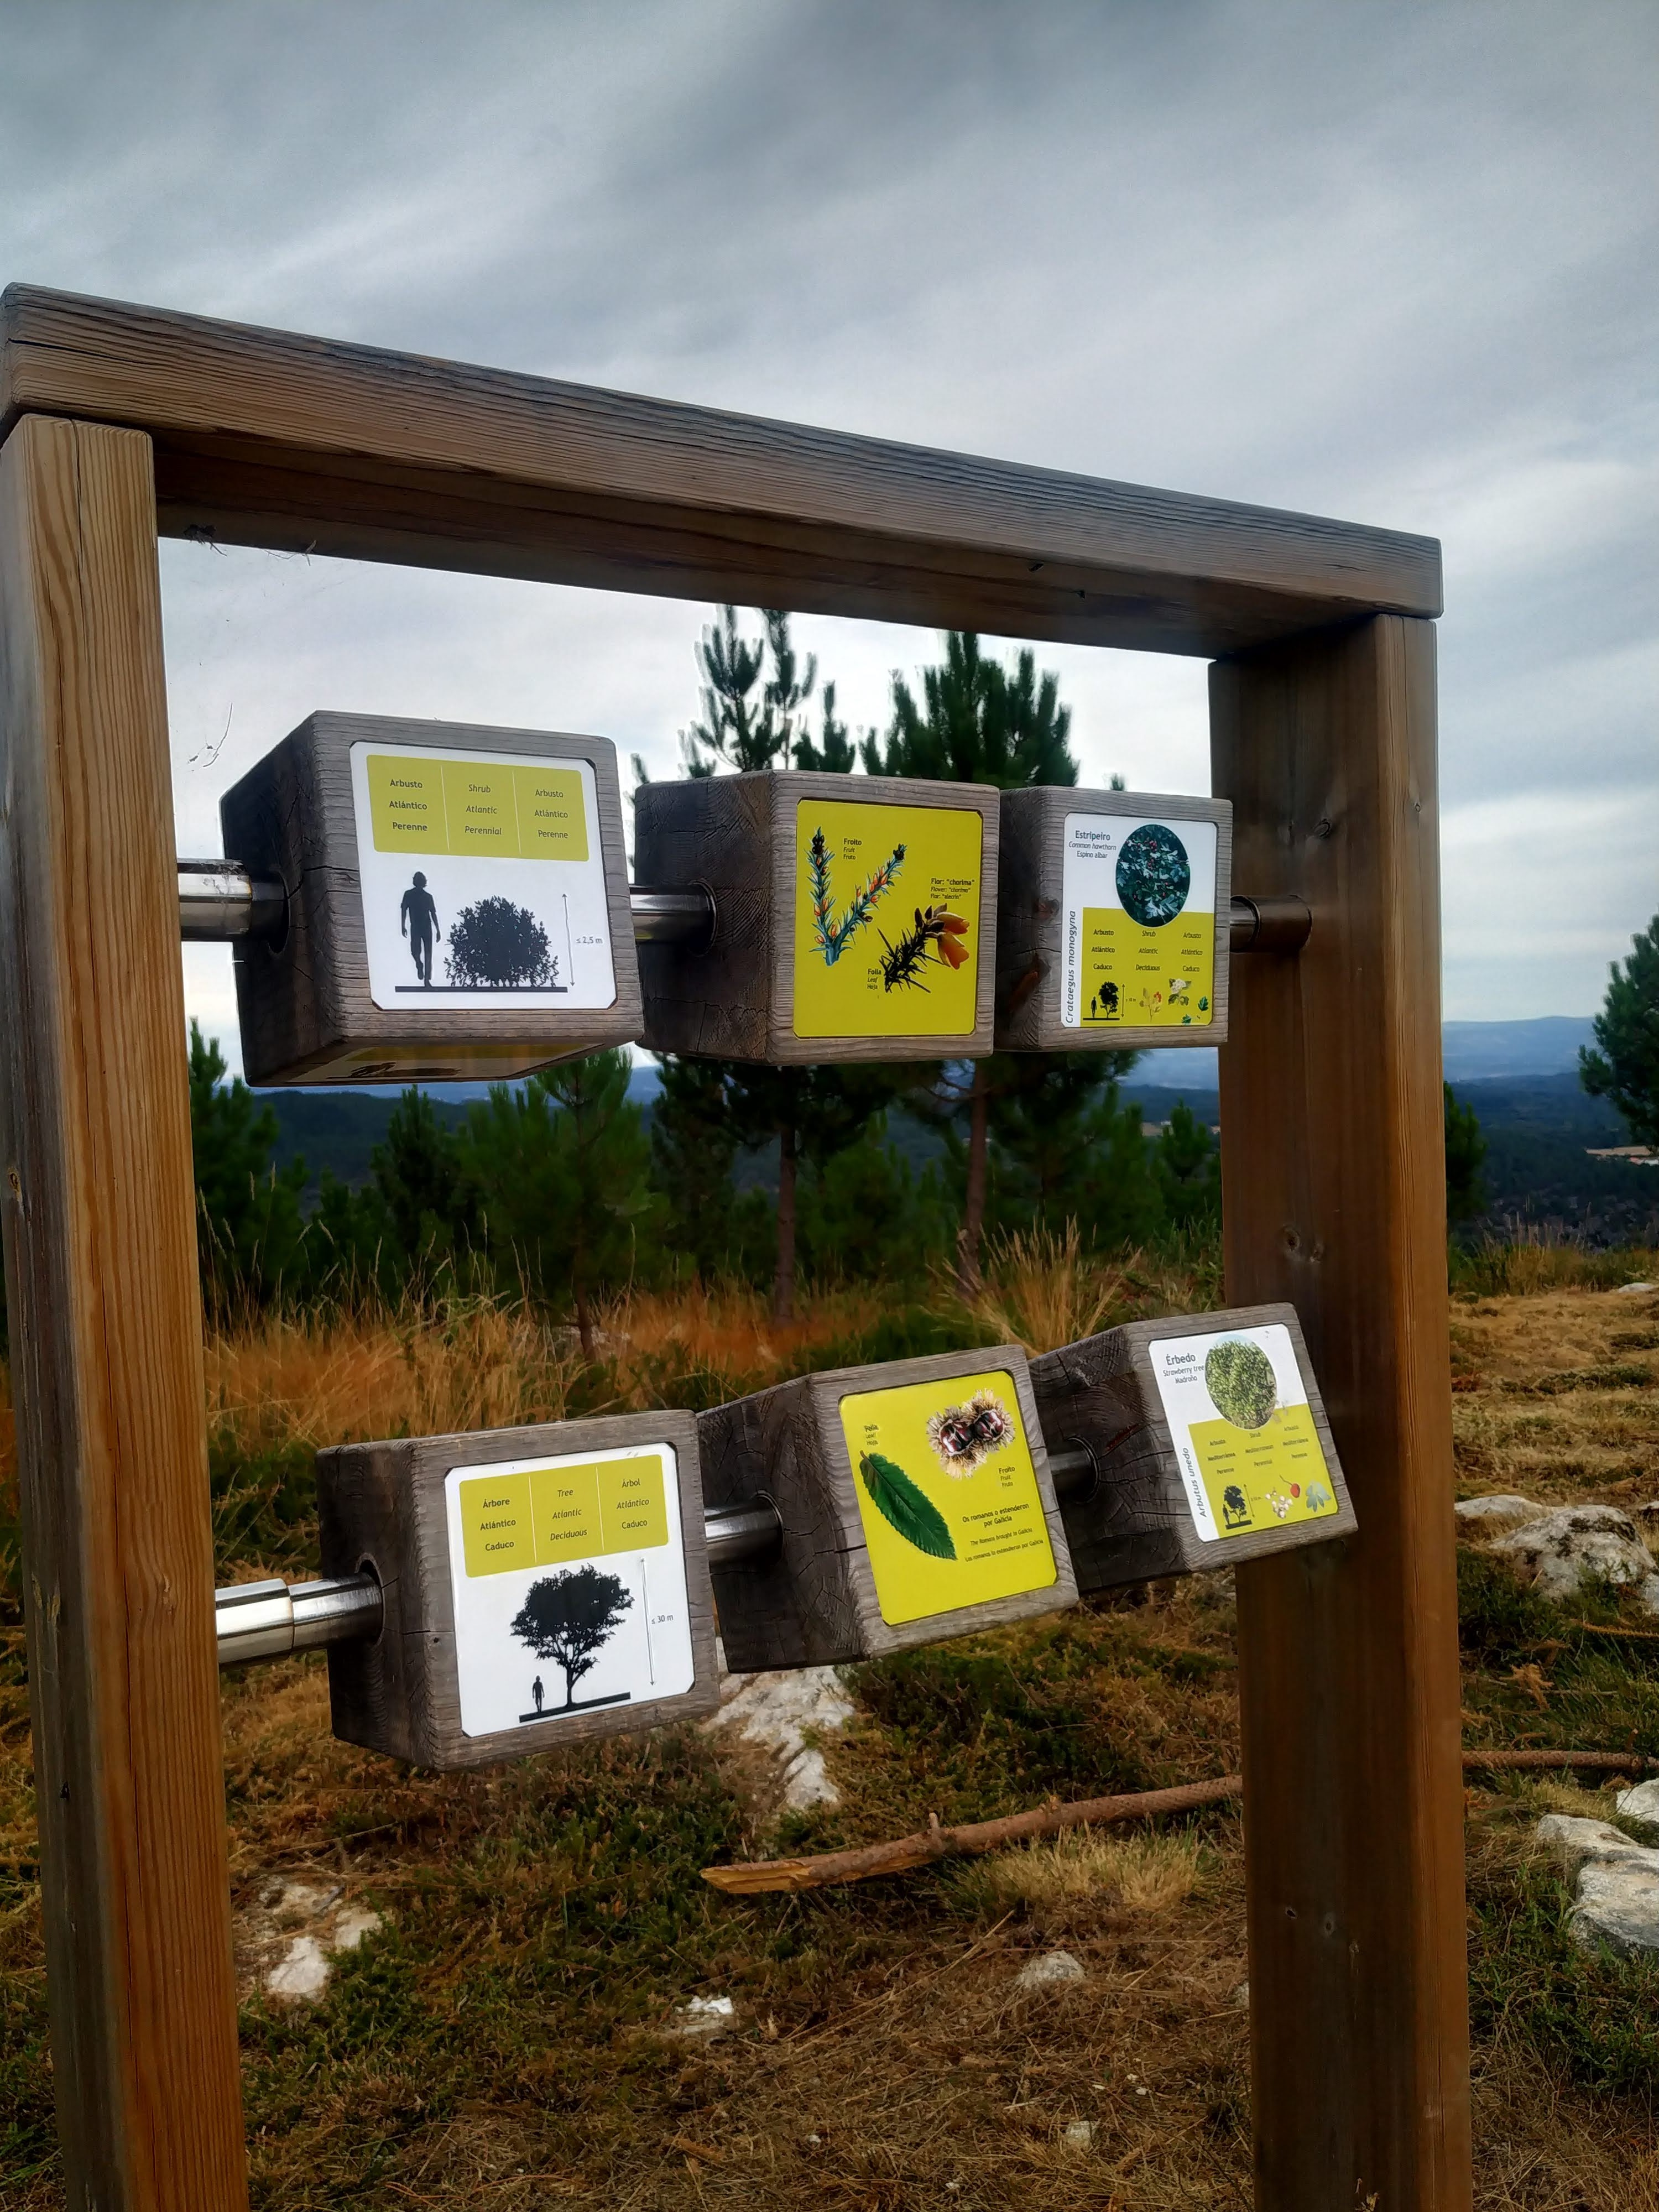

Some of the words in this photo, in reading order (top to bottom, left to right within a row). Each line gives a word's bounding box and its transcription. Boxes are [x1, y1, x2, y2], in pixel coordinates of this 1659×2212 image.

[390, 779, 422, 789] Arbusto
[468, 784, 491, 793] Shrub
[535, 789, 564, 797] Arbusto
[389, 800, 427, 810] Atlántico
[466, 805, 497, 814] Atlantic
[534, 809, 568, 818] Atlántico
[393, 822, 427, 831] Perenne
[465, 826, 502, 835] Perennial
[538, 830, 568, 838] Perenne
[1075, 830, 1110, 841] Estripeiro
[1068, 910, 1077, 966] monogyna
[1066, 969, 1076, 1024] Crataegus
[1166, 1353, 1196, 1365] Érbedo
[1163, 1368, 1192, 1376] Strawberry
[1175, 1375, 1198, 1384] Madroño
[1182, 1448, 1195, 1477] unedo
[998, 1466, 1015, 1474] Froito
[622, 1478, 641, 1488] Árbol
[557, 1489, 573, 1498] Tree
[1191, 1480, 1208, 1517] Arbutus
[483, 1499, 510, 1508] Árbore
[616, 1499, 650, 1509] Atlántico
[552, 1508, 582, 1519] Atlantic
[971, 1511, 994, 1520] romanos
[999, 1503, 1030, 1514] estenderon
[480, 1519, 516, 1531] Atlántico
[622, 1520, 648, 1529] Caduco
[983, 1520, 993, 1528] por
[994, 1515, 1013, 1524] Galicia
[550, 1528, 587, 1541] Deciduous
[485, 1541, 514, 1551] Caduco
[657, 1615, 665, 1623] 30
